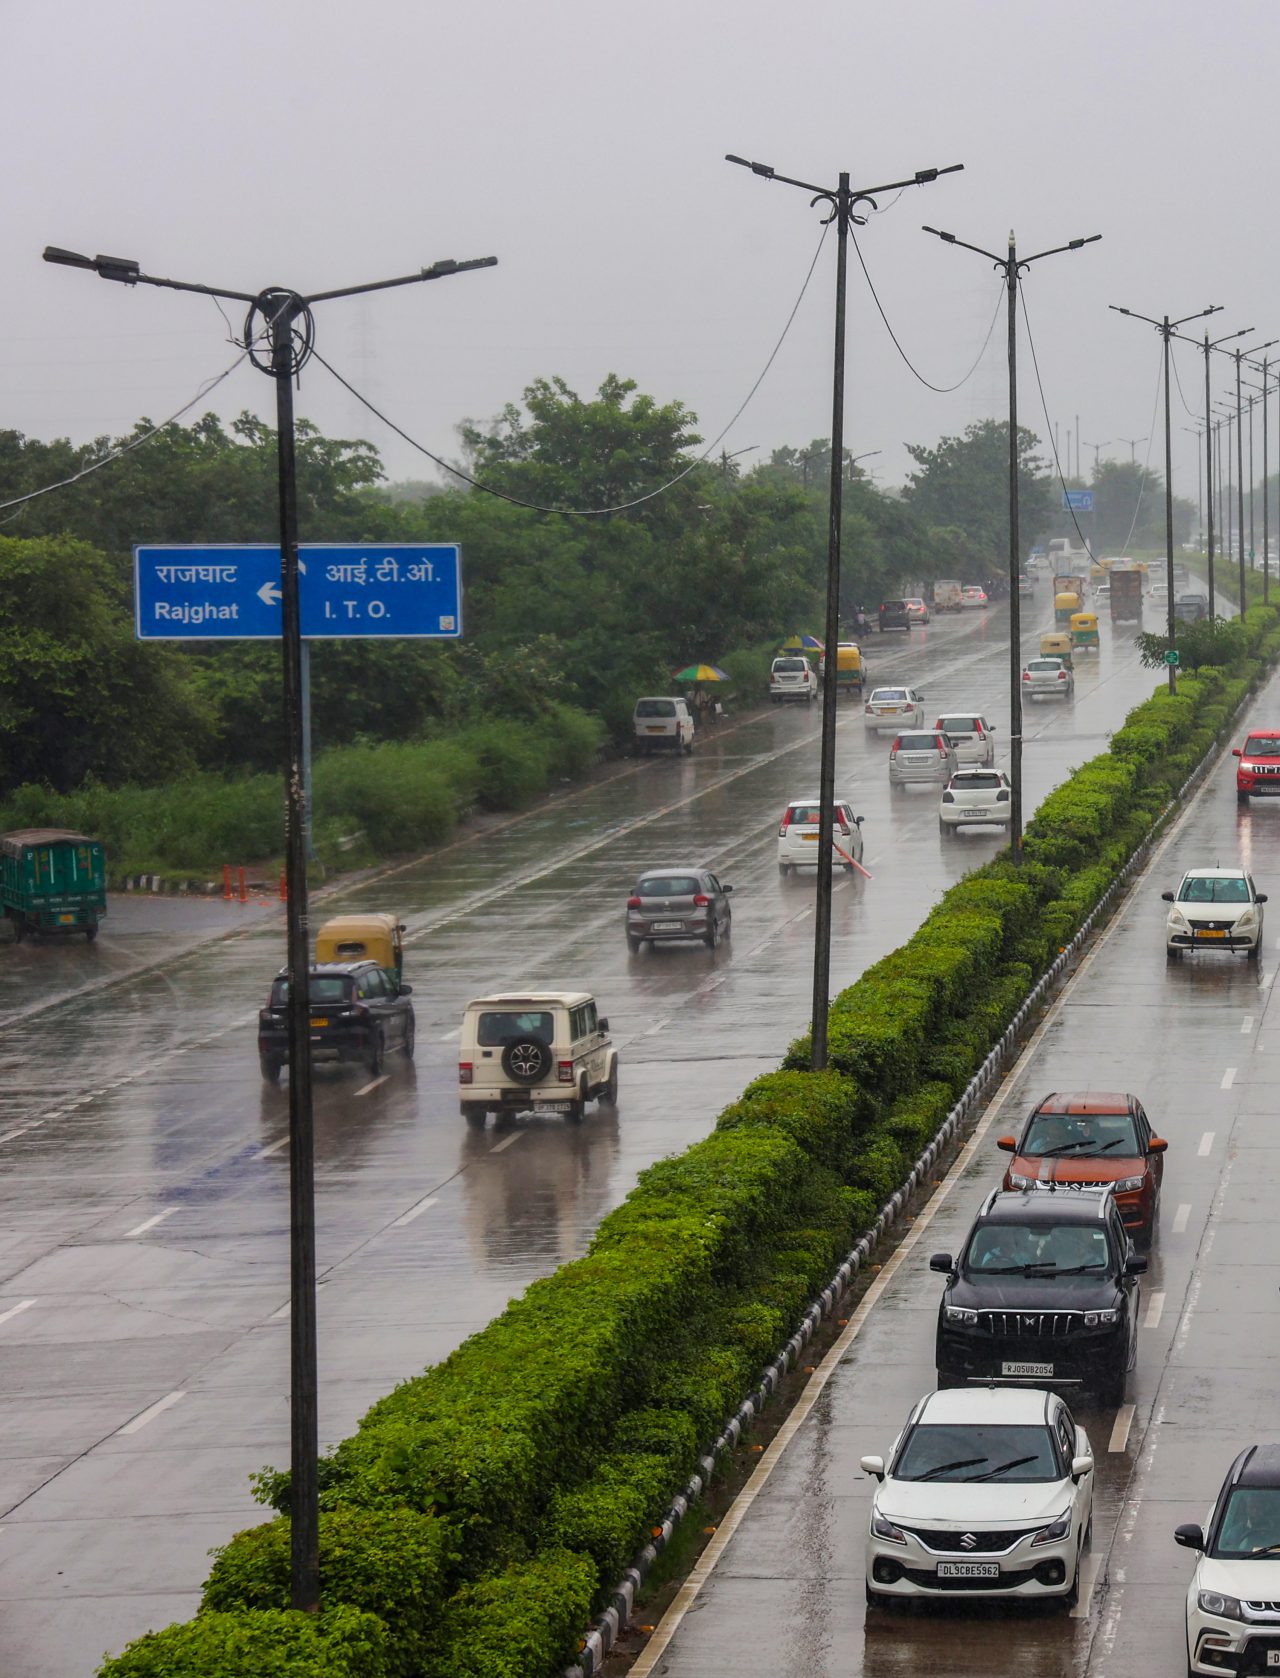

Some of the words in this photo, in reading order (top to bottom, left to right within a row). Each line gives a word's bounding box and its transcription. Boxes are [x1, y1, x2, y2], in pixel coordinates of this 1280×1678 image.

[155, 566, 237, 583] राजघाट
[154, 602, 238, 624] Rajghat
[943, 1566, 998, 1576] DL9CBE5962
